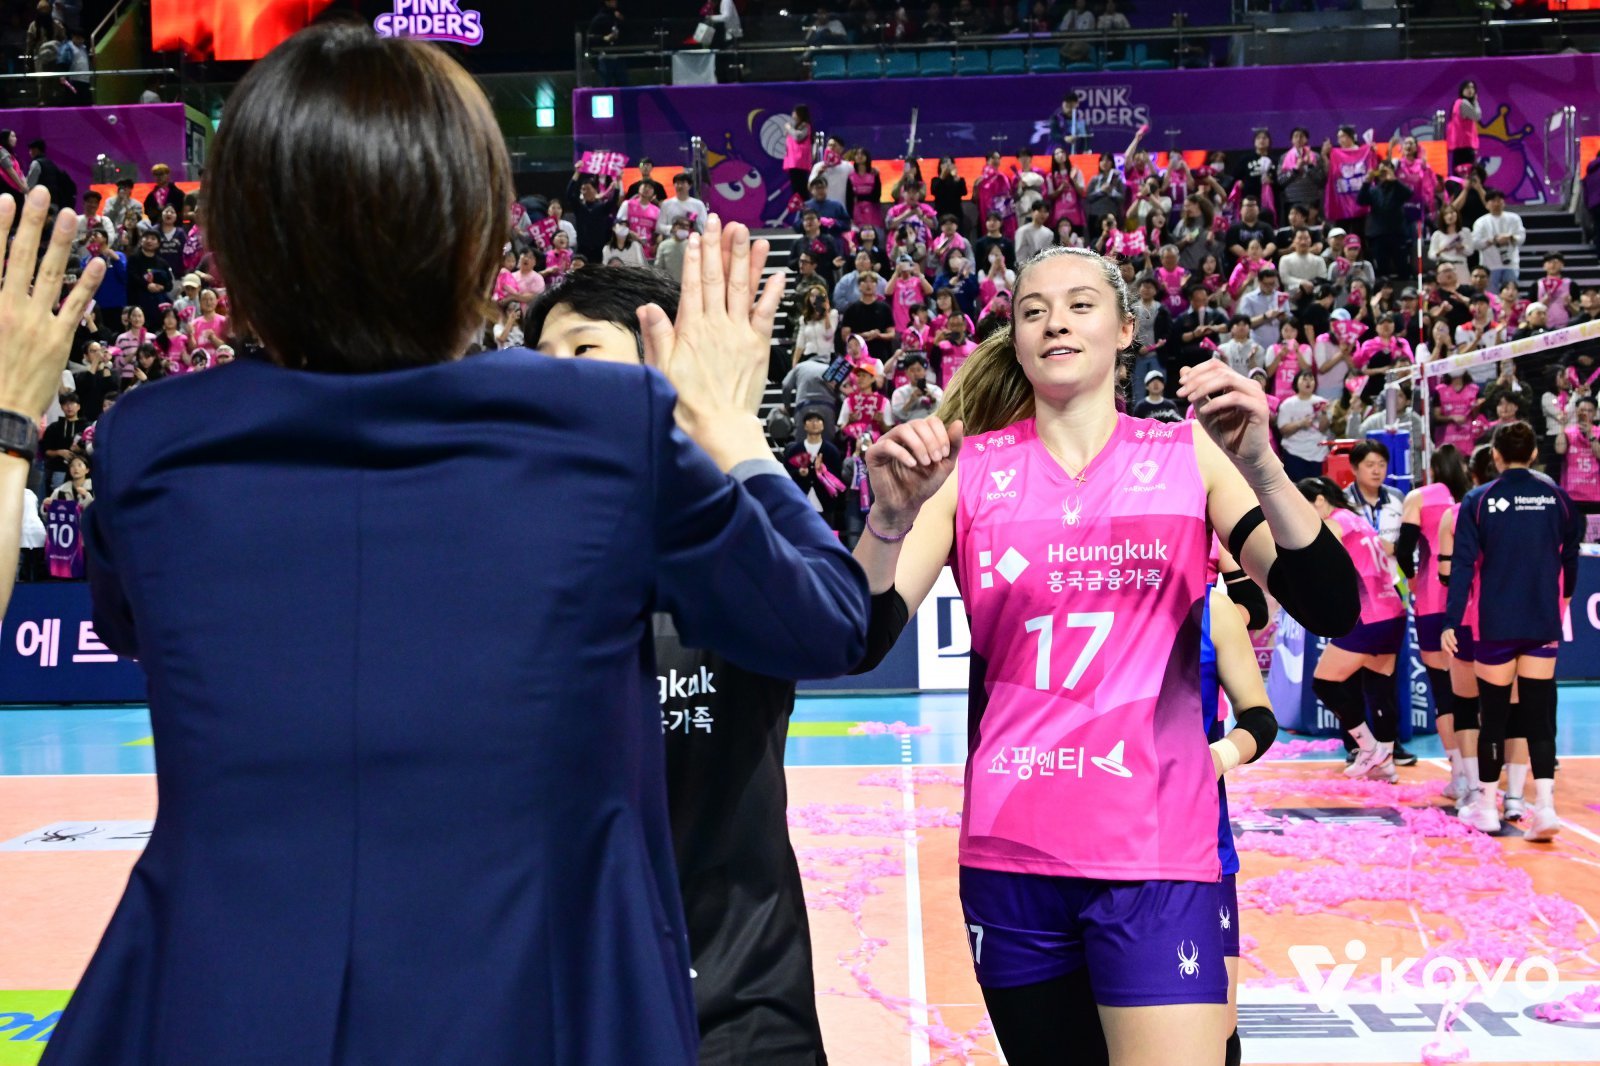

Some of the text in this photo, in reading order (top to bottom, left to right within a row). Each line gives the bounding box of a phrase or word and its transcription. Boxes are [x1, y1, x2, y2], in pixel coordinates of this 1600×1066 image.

[396, 0, 458, 14] PINK
[377, 13, 480, 39] SPIDERS
[1074, 88, 1128, 107] PINK
[1077, 107, 1149, 127] IDERS
[1280, 369, 1296, 383] 15
[1576, 457, 1592, 473] 15
[987, 491, 1017, 501] KOVO
[1123, 483, 1167, 494] TAEKWANG
[1514, 495, 1557, 506] Heungkuk
[49, 523, 74, 548] 10
[1047, 538, 1168, 564] Heungkuk
[1047, 569, 1163, 594] 흥국금융가족
[16, 618, 139, 667] 에트
[1025, 611, 1115, 690] 17
[656, 665, 717, 704] gkuk
[660, 706, 715, 735] 가족
[987, 746, 1083, 780] 쇼핑엔티
[965, 923, 984, 965] 7
